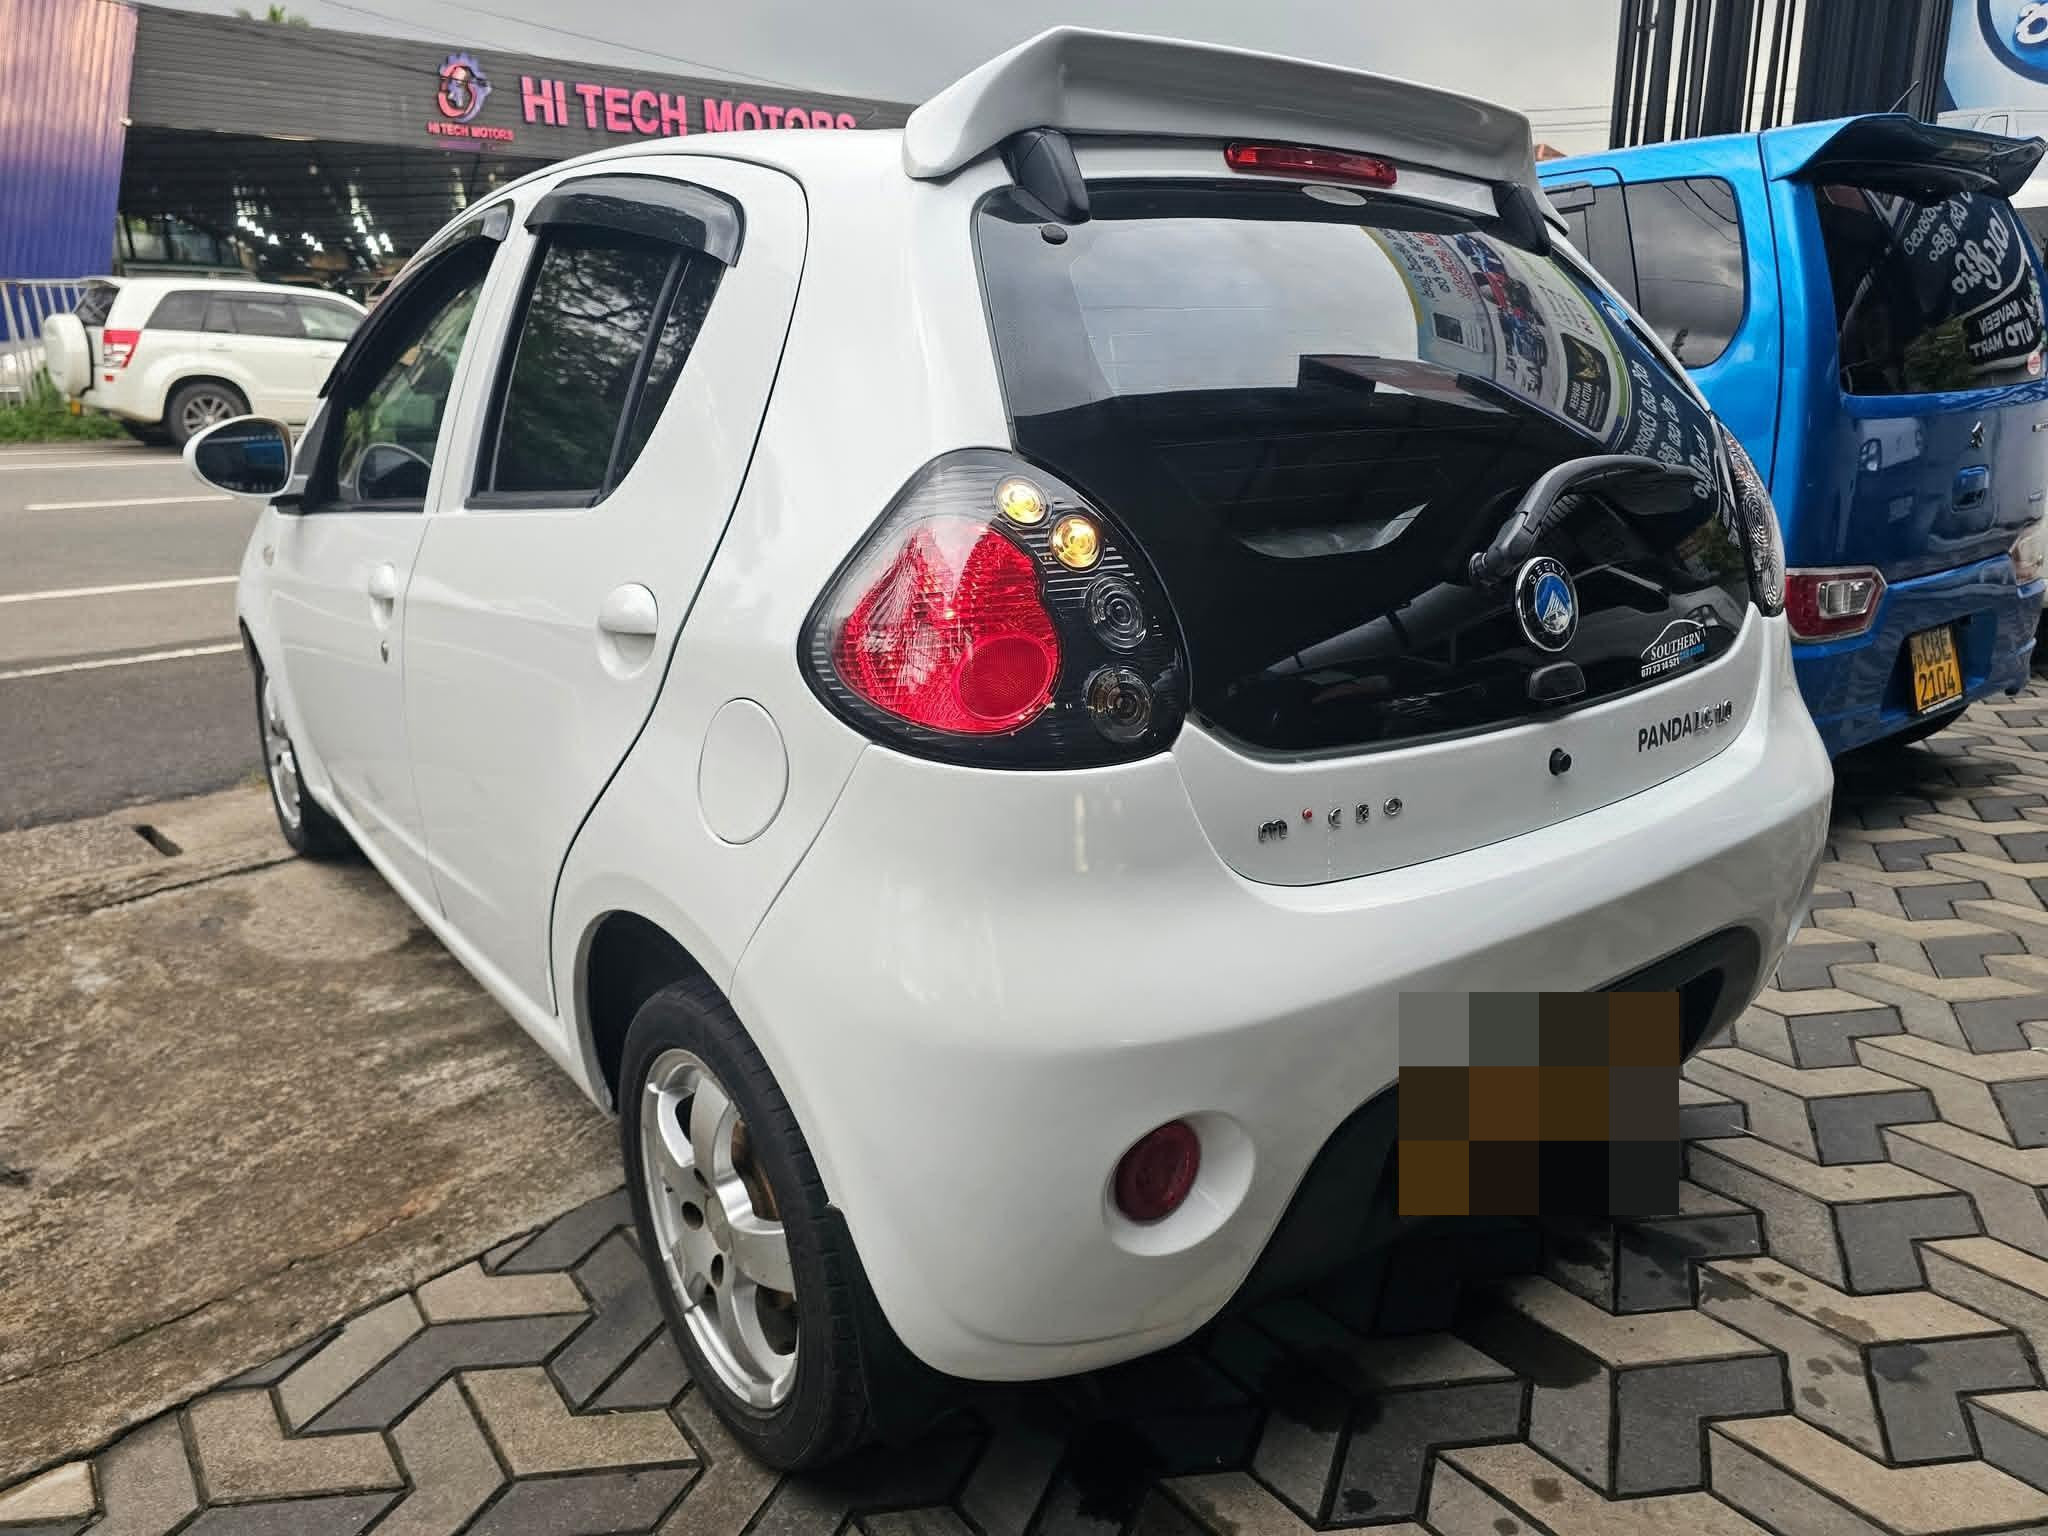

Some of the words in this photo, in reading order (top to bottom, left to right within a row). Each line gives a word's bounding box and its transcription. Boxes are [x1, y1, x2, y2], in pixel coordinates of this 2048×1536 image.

[521, 76, 568, 126] HI
[575, 83, 688, 137] TECH
[440, 123, 469, 137] TECH
[1650, 631, 1701, 661] SOUTHERN
[1919, 663, 1956, 706] 2104
[1638, 713, 1692, 753] PANDA
